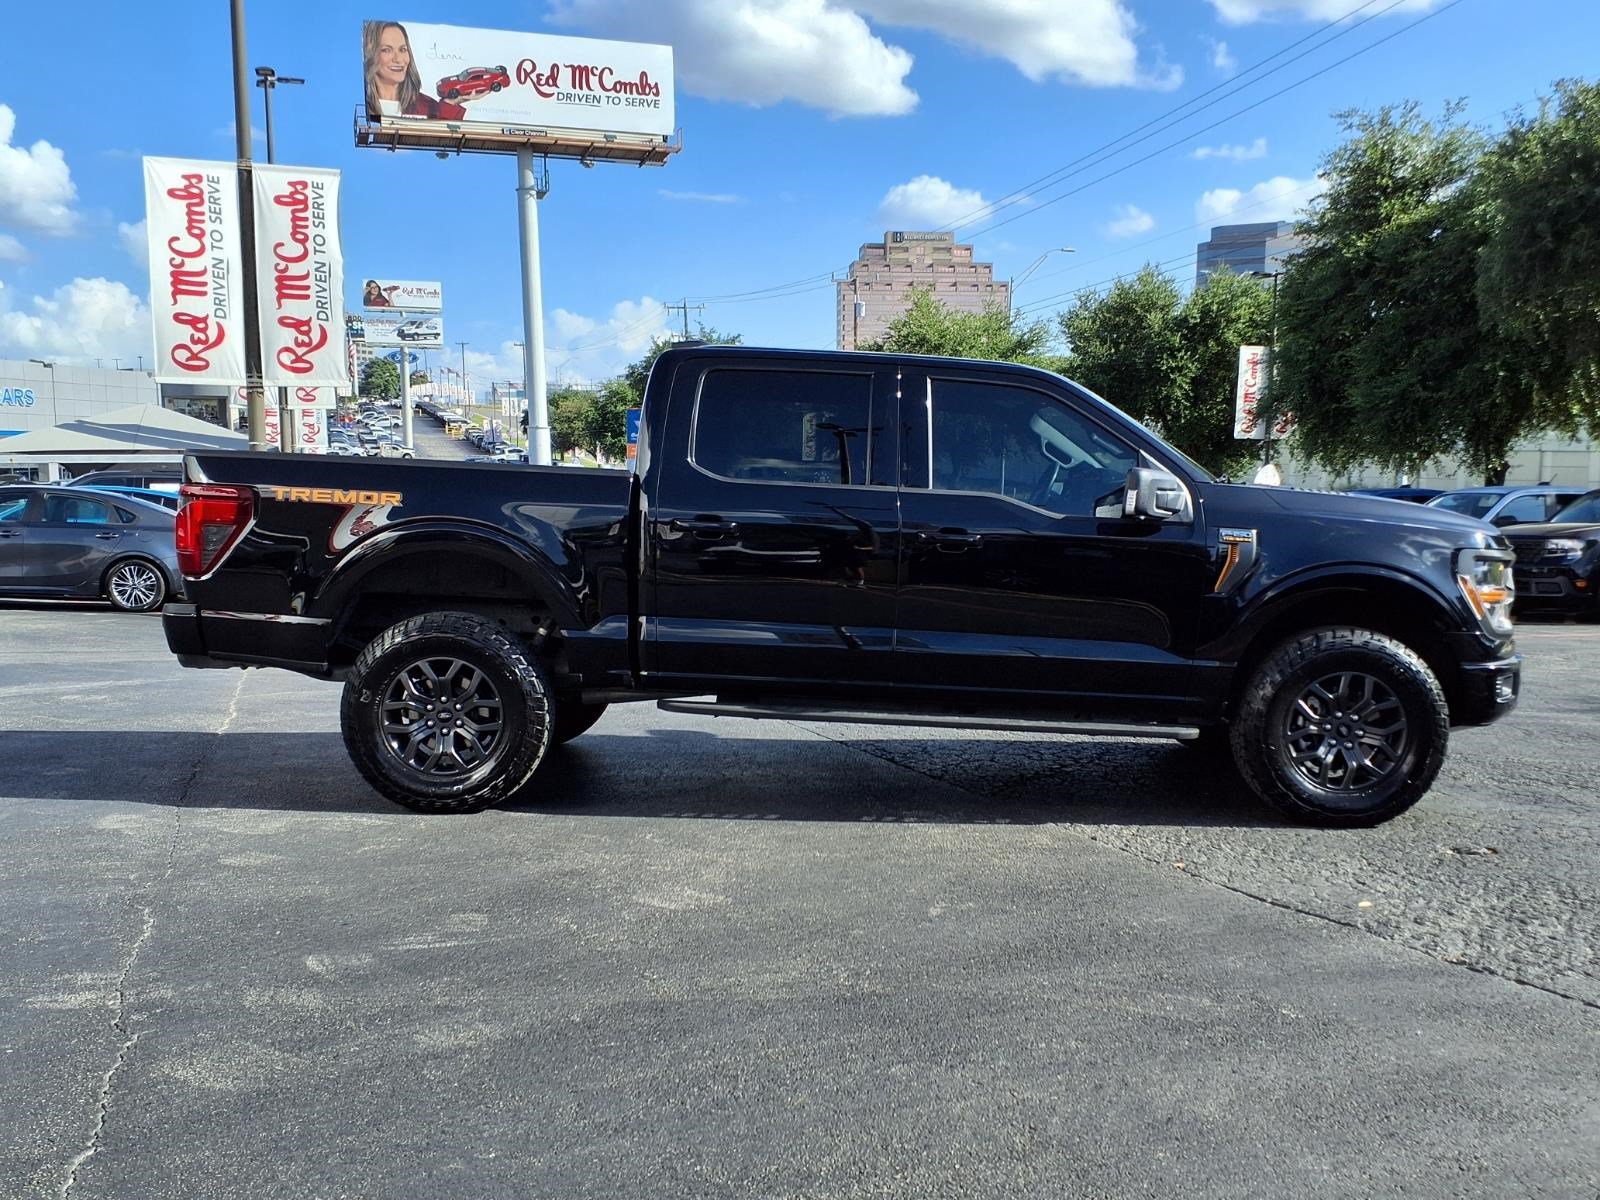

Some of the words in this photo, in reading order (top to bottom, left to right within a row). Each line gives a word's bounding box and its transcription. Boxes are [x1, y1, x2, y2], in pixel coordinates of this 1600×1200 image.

[516, 58, 560, 98] Red
[563, 63, 660, 97] McCombs
[556, 91, 602, 106] DRIVEN
[605, 95, 622, 106] TO
[624, 97, 661, 109] SERVE
[206, 174, 224, 226] SERVE
[311, 181, 326, 230] SERVE
[167, 173, 208, 307] McCombs
[209, 229, 224, 255] TO
[272, 180, 311, 310] McCombs
[312, 233, 326, 259] TO
[209, 257, 227, 321] DRIVEN
[311, 261, 329, 322] DRIVEN
[171, 312, 225, 372] Red
[276, 316, 328, 374] Red
[0, 387, 35, 408] ARS
[301, 422, 320, 443] Red
[271, 487, 402, 506] TREMOR
